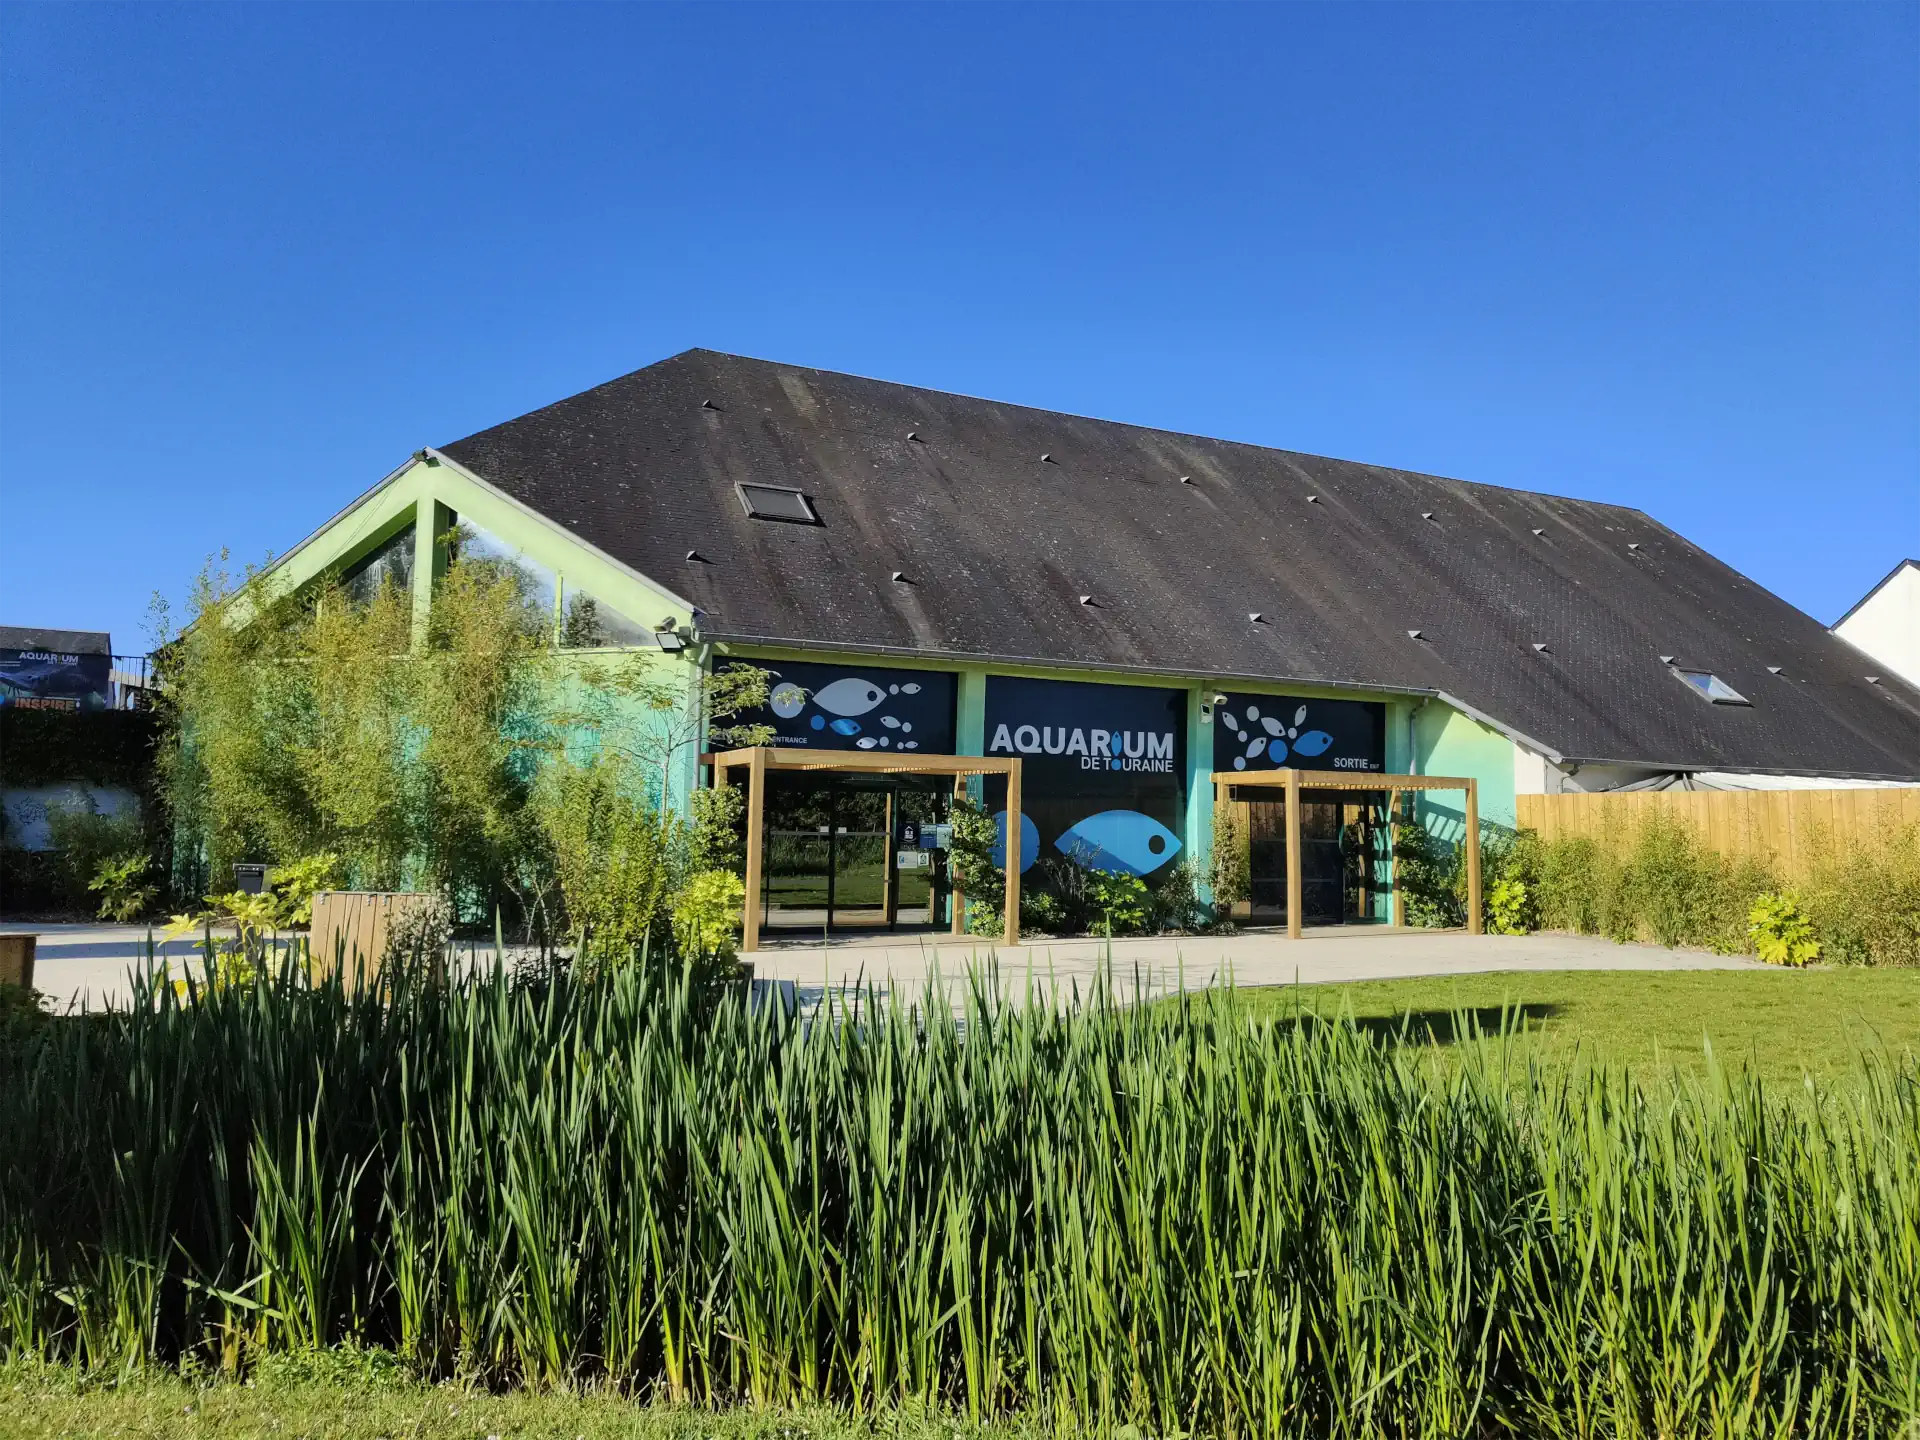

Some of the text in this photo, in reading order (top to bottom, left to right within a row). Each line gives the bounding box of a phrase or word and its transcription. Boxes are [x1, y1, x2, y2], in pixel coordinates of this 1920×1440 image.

[989, 723, 1173, 759] AQUARIUM
[1081, 756, 1173, 772] DE TOURAINE
[1334, 757, 1369, 769] SORTIE
